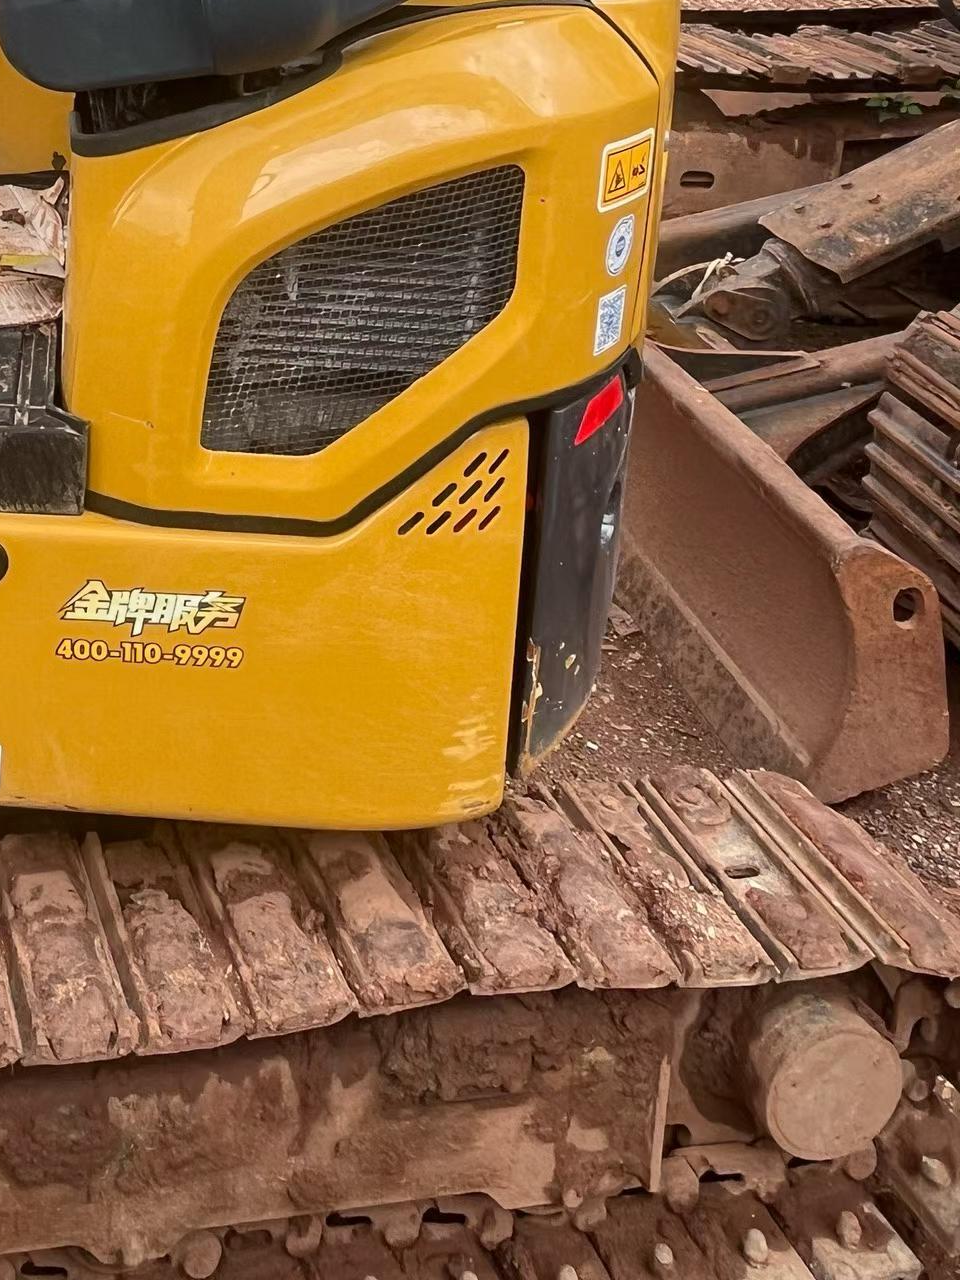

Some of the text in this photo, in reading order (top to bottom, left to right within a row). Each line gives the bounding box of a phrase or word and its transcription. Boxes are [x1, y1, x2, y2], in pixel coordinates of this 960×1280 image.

[58, 579, 246, 637] 金牌服务
[56, 638, 244, 668] 400-110-9999
